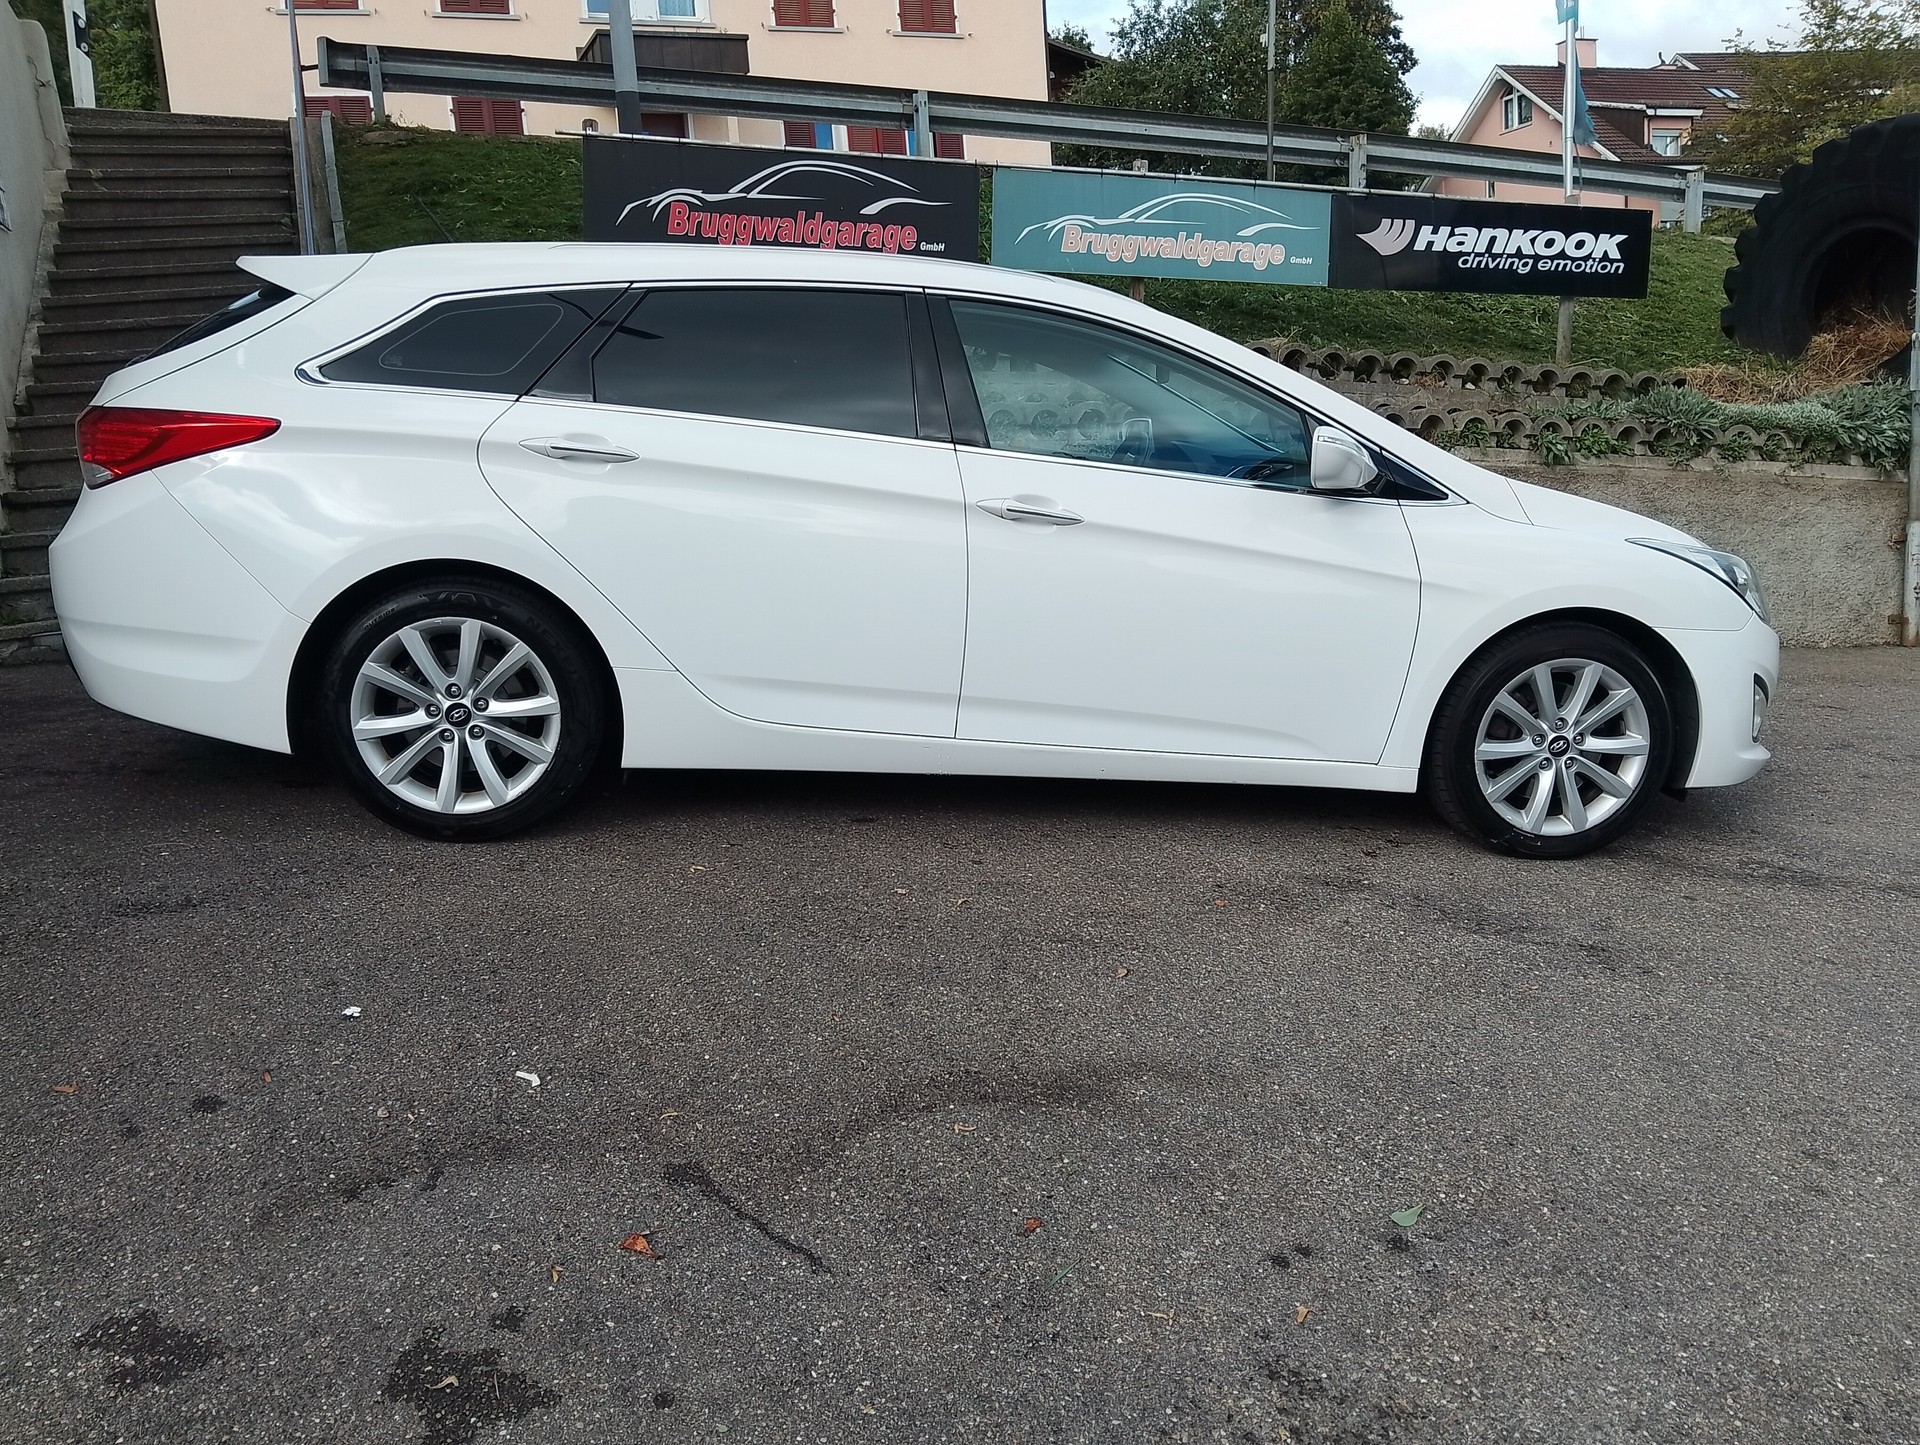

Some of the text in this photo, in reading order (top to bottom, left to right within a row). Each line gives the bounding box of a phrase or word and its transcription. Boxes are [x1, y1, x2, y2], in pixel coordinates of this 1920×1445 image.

[667, 202, 946, 254] Bruggwaldgarage GmbH
[1061, 224, 1313, 270] Bruggwaldgarage GmbH
[1458, 253, 1625, 275] driving emotion
